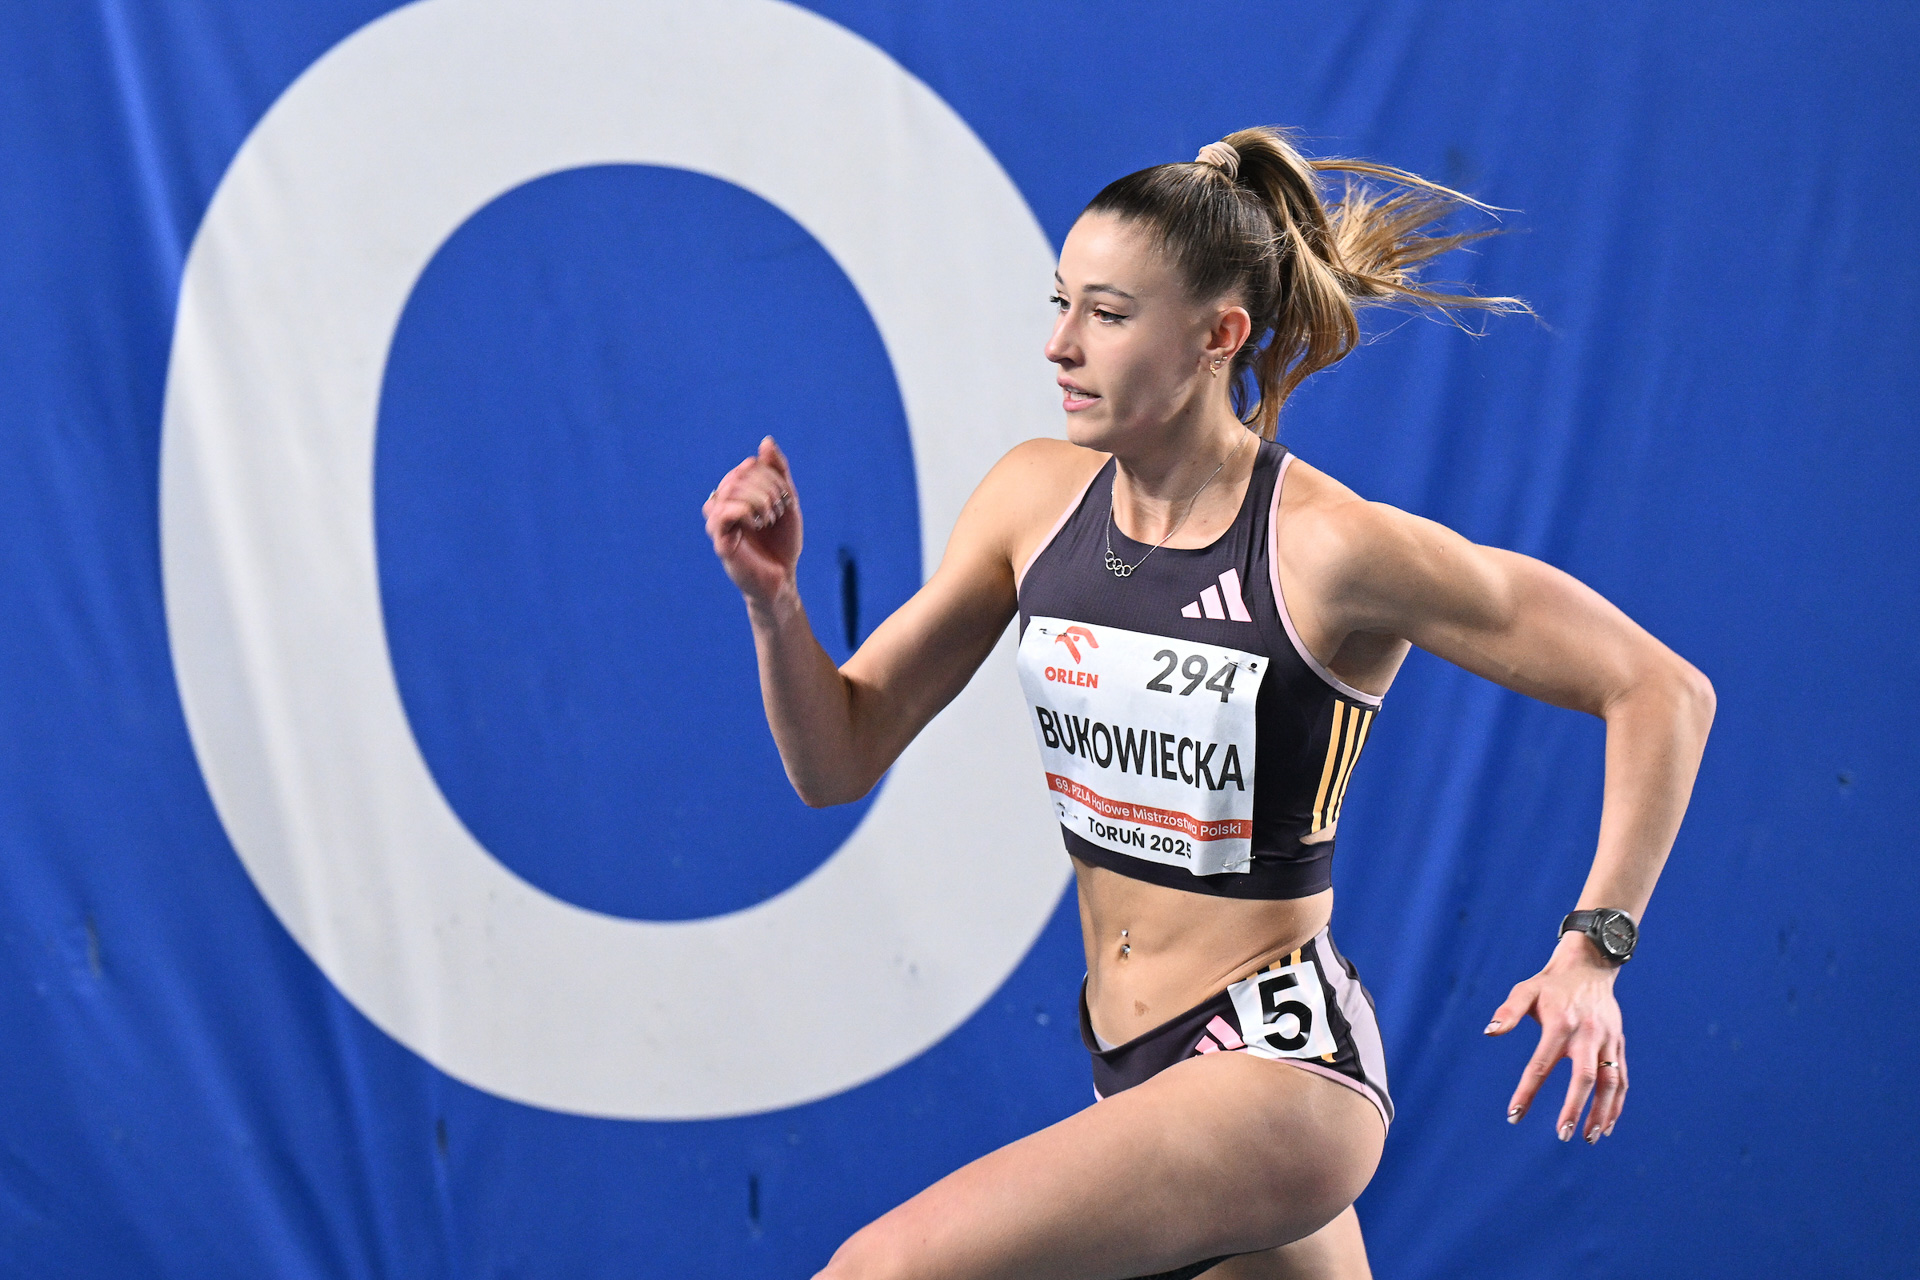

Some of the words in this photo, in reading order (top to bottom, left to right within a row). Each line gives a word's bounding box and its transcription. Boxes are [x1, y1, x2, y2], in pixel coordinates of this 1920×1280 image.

[1044, 666, 1099, 689] ORLEN
[1146, 649, 1235, 703] 294
[1036, 706, 1245, 791] BUKOWIECKA
[1055, 778, 1071, 793] 69.
[1072, 784, 1091, 804] PZLA
[1091, 797, 1130, 818] Halowe
[1132, 808, 1198, 835] Mistrzostwa
[1200, 823, 1242, 837] Polski
[1088, 817, 1145, 849] TORUŃ
[1150, 835, 1192, 859] 2025
[1258, 973, 1313, 1051] 5
